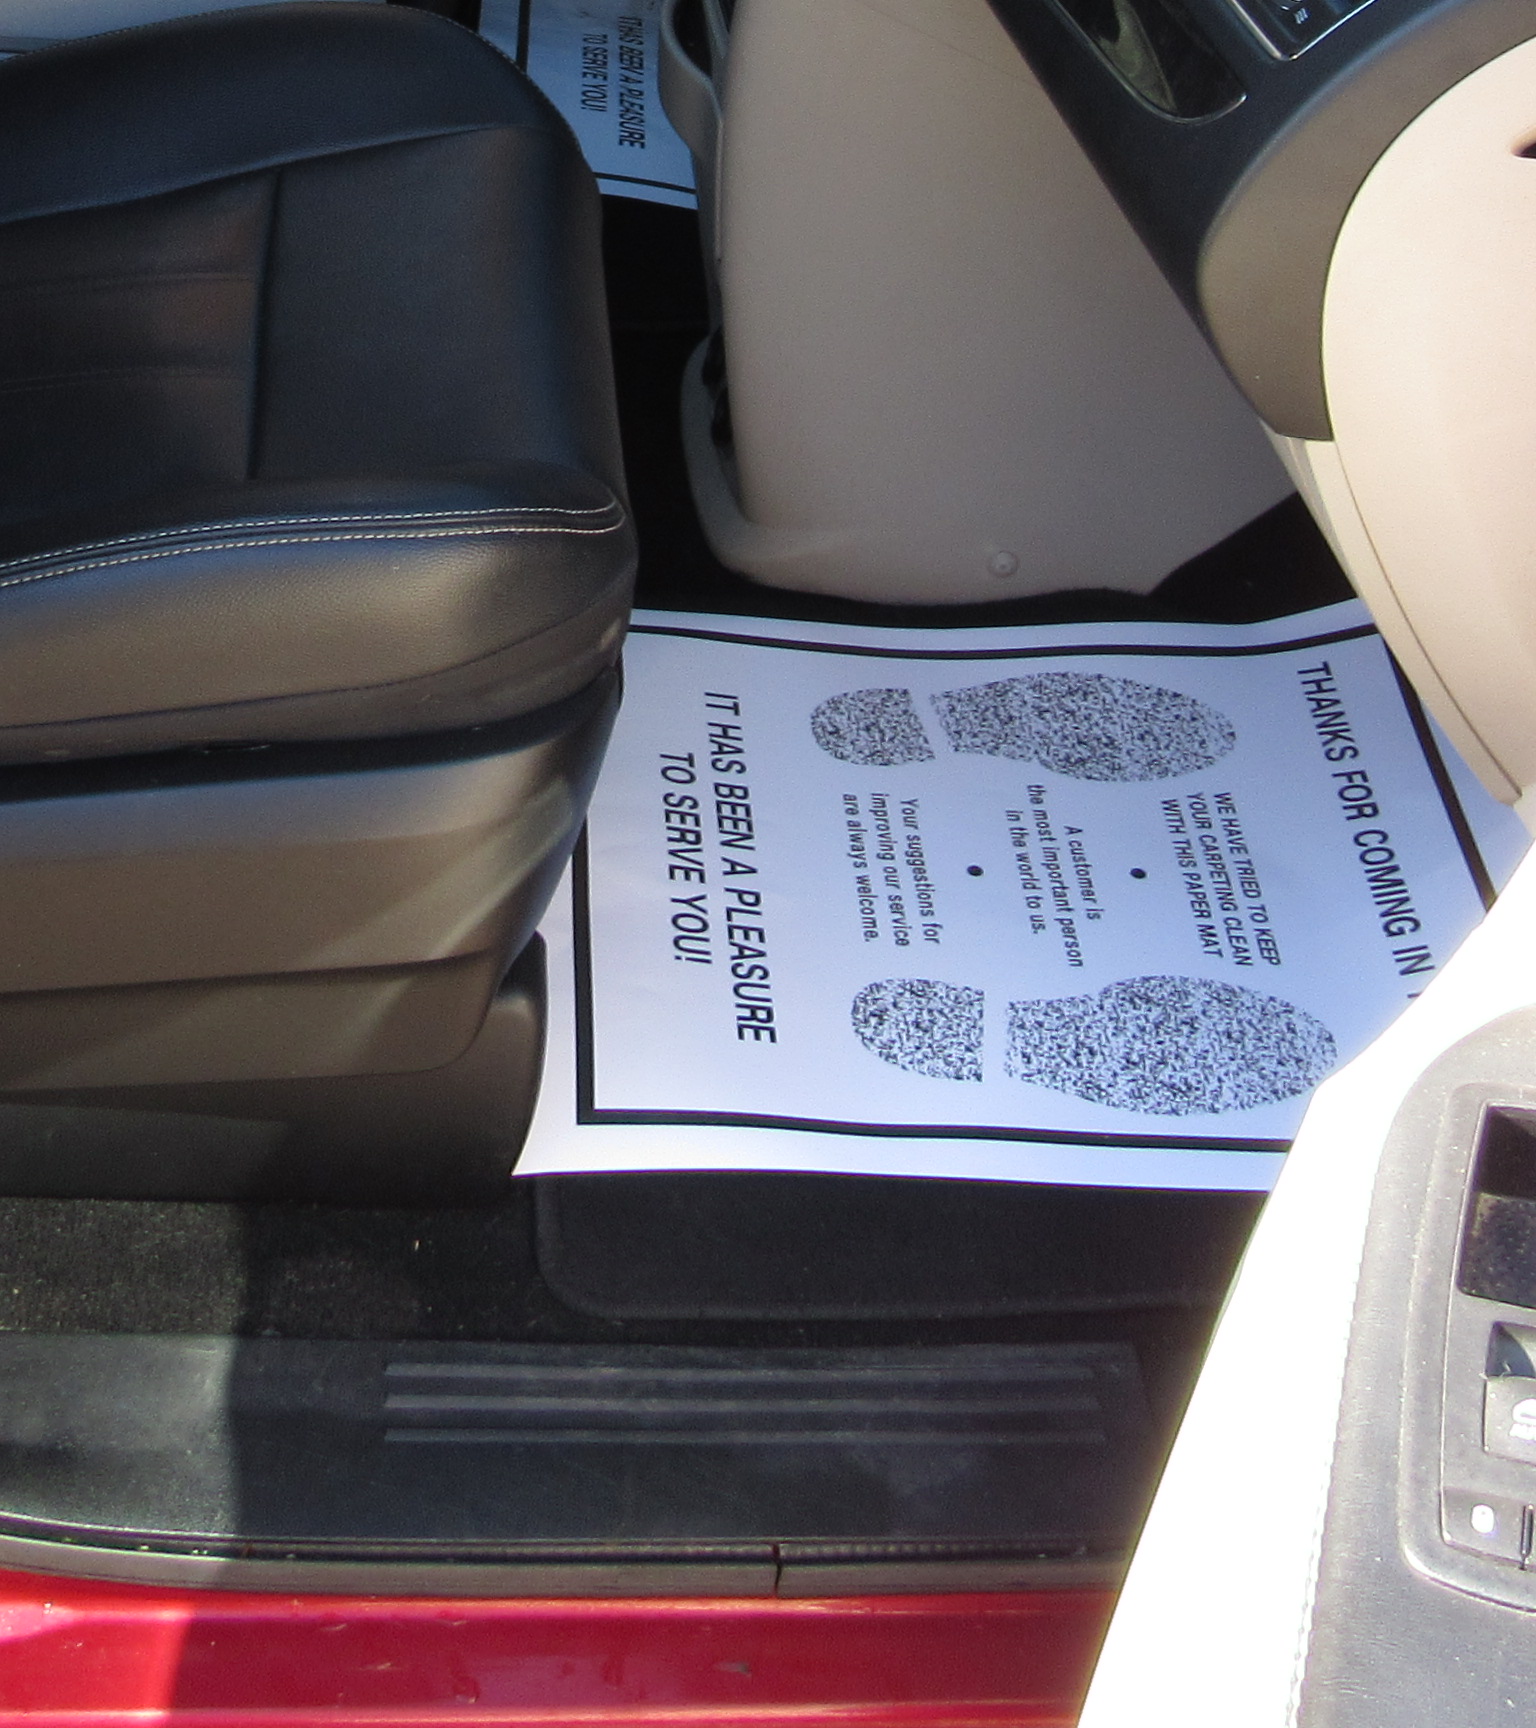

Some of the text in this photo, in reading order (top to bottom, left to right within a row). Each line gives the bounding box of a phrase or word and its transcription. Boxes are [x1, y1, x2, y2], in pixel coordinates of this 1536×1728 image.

[580, 33, 608, 112] TO SERVE YOU!
[618, 84, 646, 149] PLEASURE
[619, 73, 643, 84] A
[660, 752, 713, 964] TO SERVE YOU!
[704, 692, 777, 1043] IT HAS BEEN A PLEASURE
[842, 793, 879, 942] are always welcome.
[869, 793, 913, 946] improving our service
[900, 798, 943, 944] Your suggestions for
[1005, 809, 1046, 934] in the world to us.
[1027, 784, 1084, 967] the most important person
[1063, 825, 1105, 920] A customer is
[1161, 798, 1224, 958] WITH THIS PAPER MAT
[1186, 792, 1253, 966] YOUR CARPETING CLEAN
[1213, 791, 1281, 966] WE HAVE TRIED TO KEEP
[1297, 661, 1436, 976] THANKS FOR COMING IN
